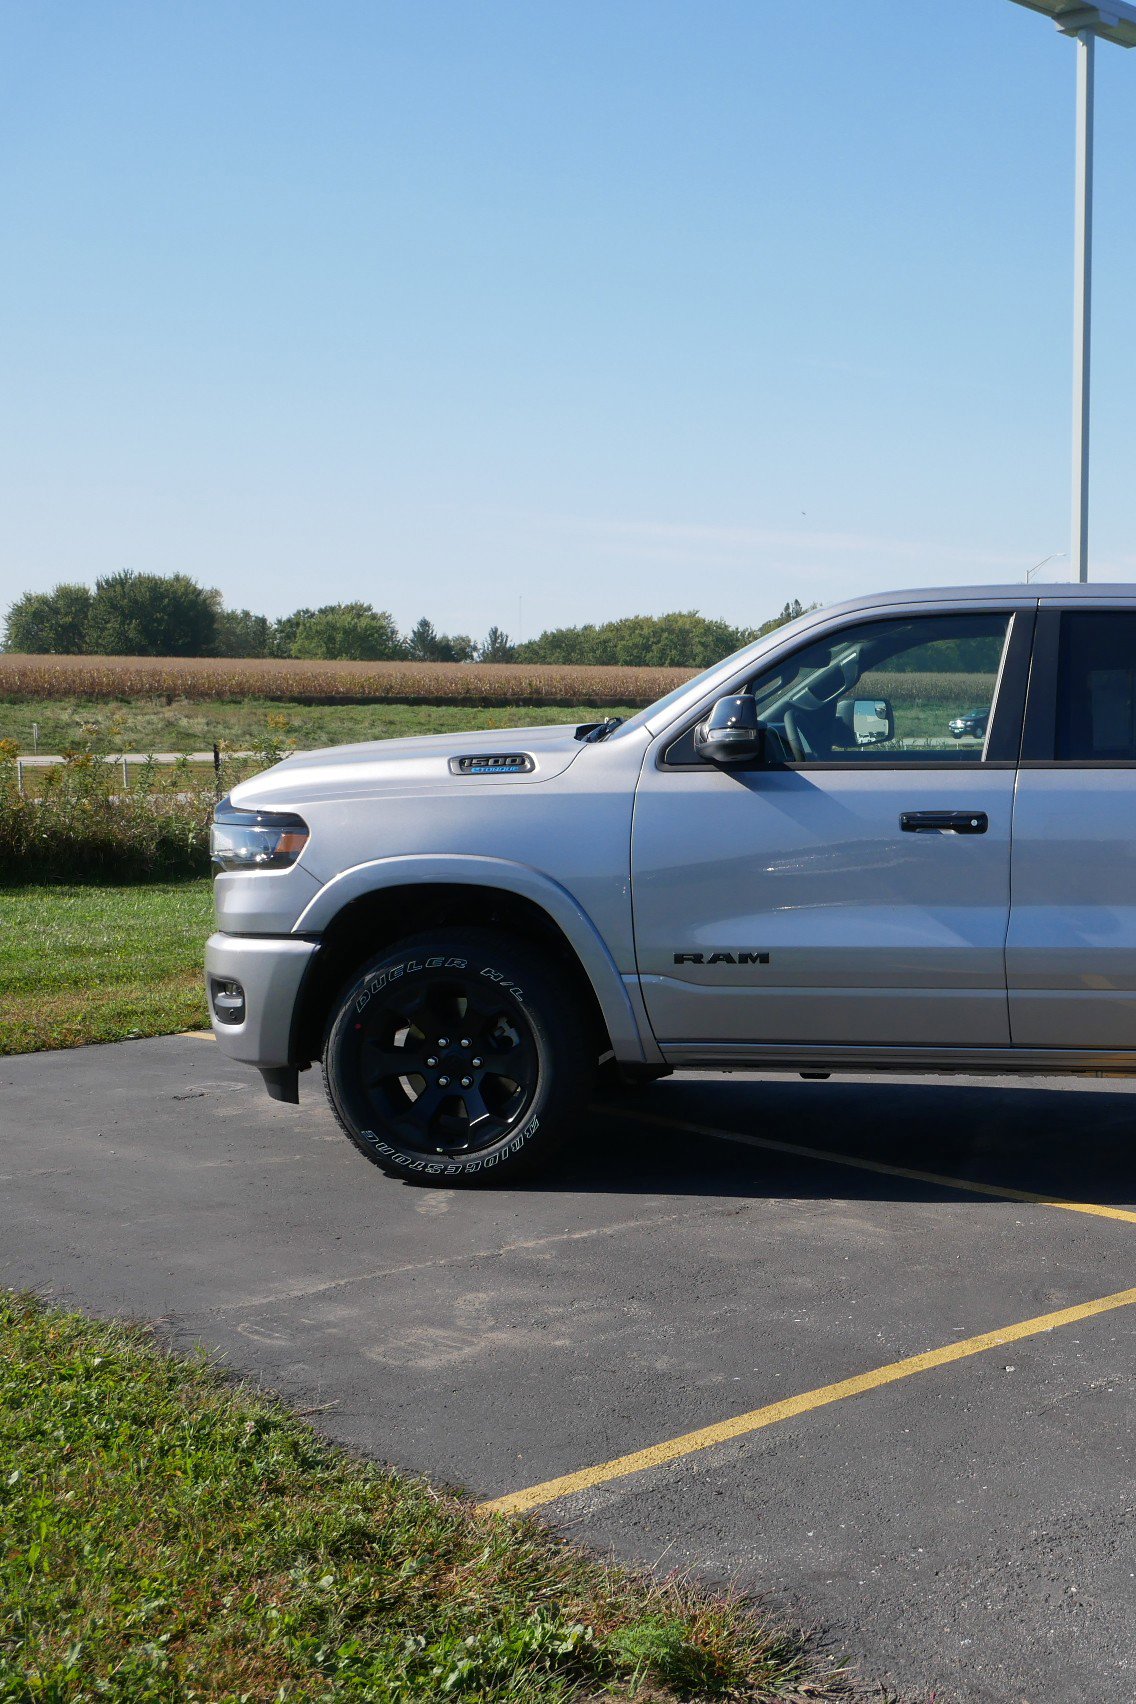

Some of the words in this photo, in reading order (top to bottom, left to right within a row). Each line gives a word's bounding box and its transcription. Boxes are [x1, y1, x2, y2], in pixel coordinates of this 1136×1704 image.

[462, 757, 522, 767] 1500
[672, 952, 770, 965] RAM
[355, 957, 467, 1013] DUELER
[361, 1114, 541, 1175] BRIDGESTONE
